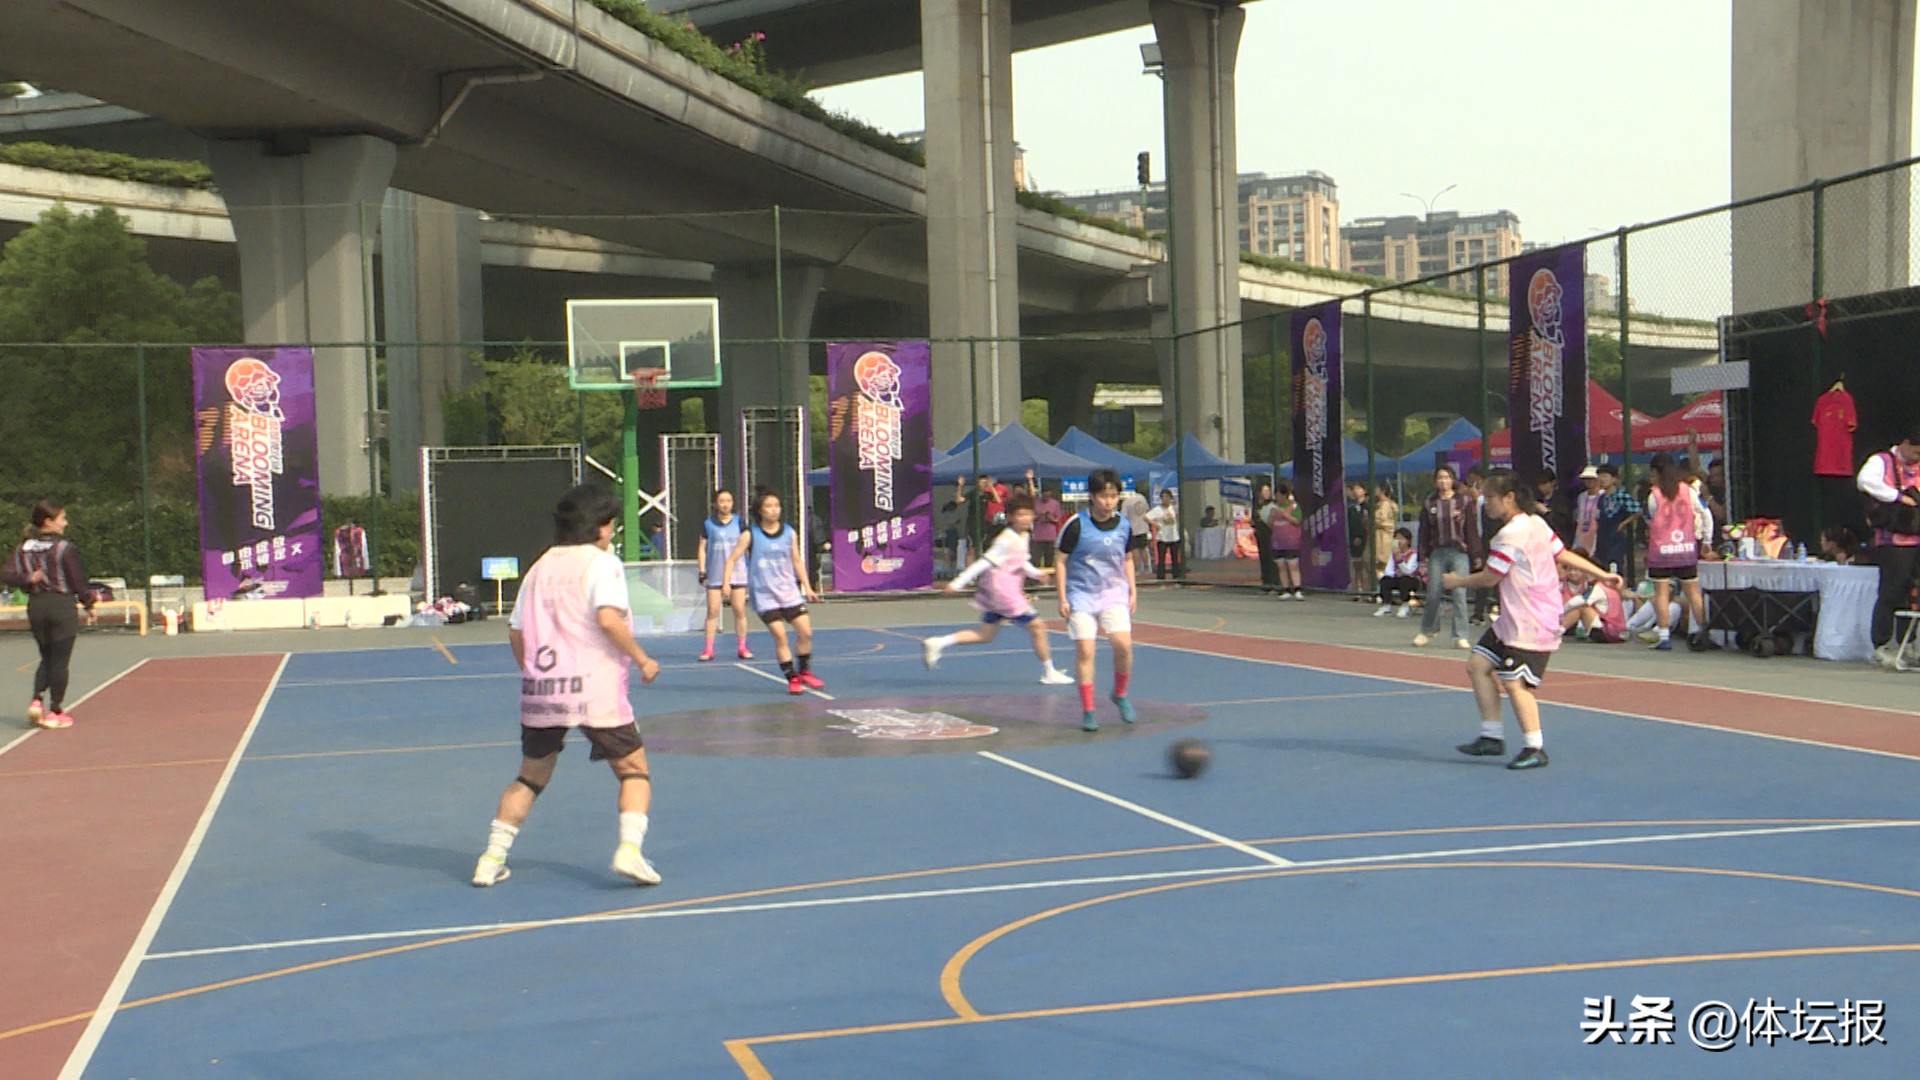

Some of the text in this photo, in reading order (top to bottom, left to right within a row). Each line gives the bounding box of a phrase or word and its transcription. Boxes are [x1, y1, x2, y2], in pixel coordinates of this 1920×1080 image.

[234, 406, 252, 483] ARENA
[860, 399, 876, 468] ARENA
[876, 404, 893, 510] BLOOMING
[1542, 341, 1557, 470] BLOOMIN
[251, 414, 273, 529] BLOOMING
